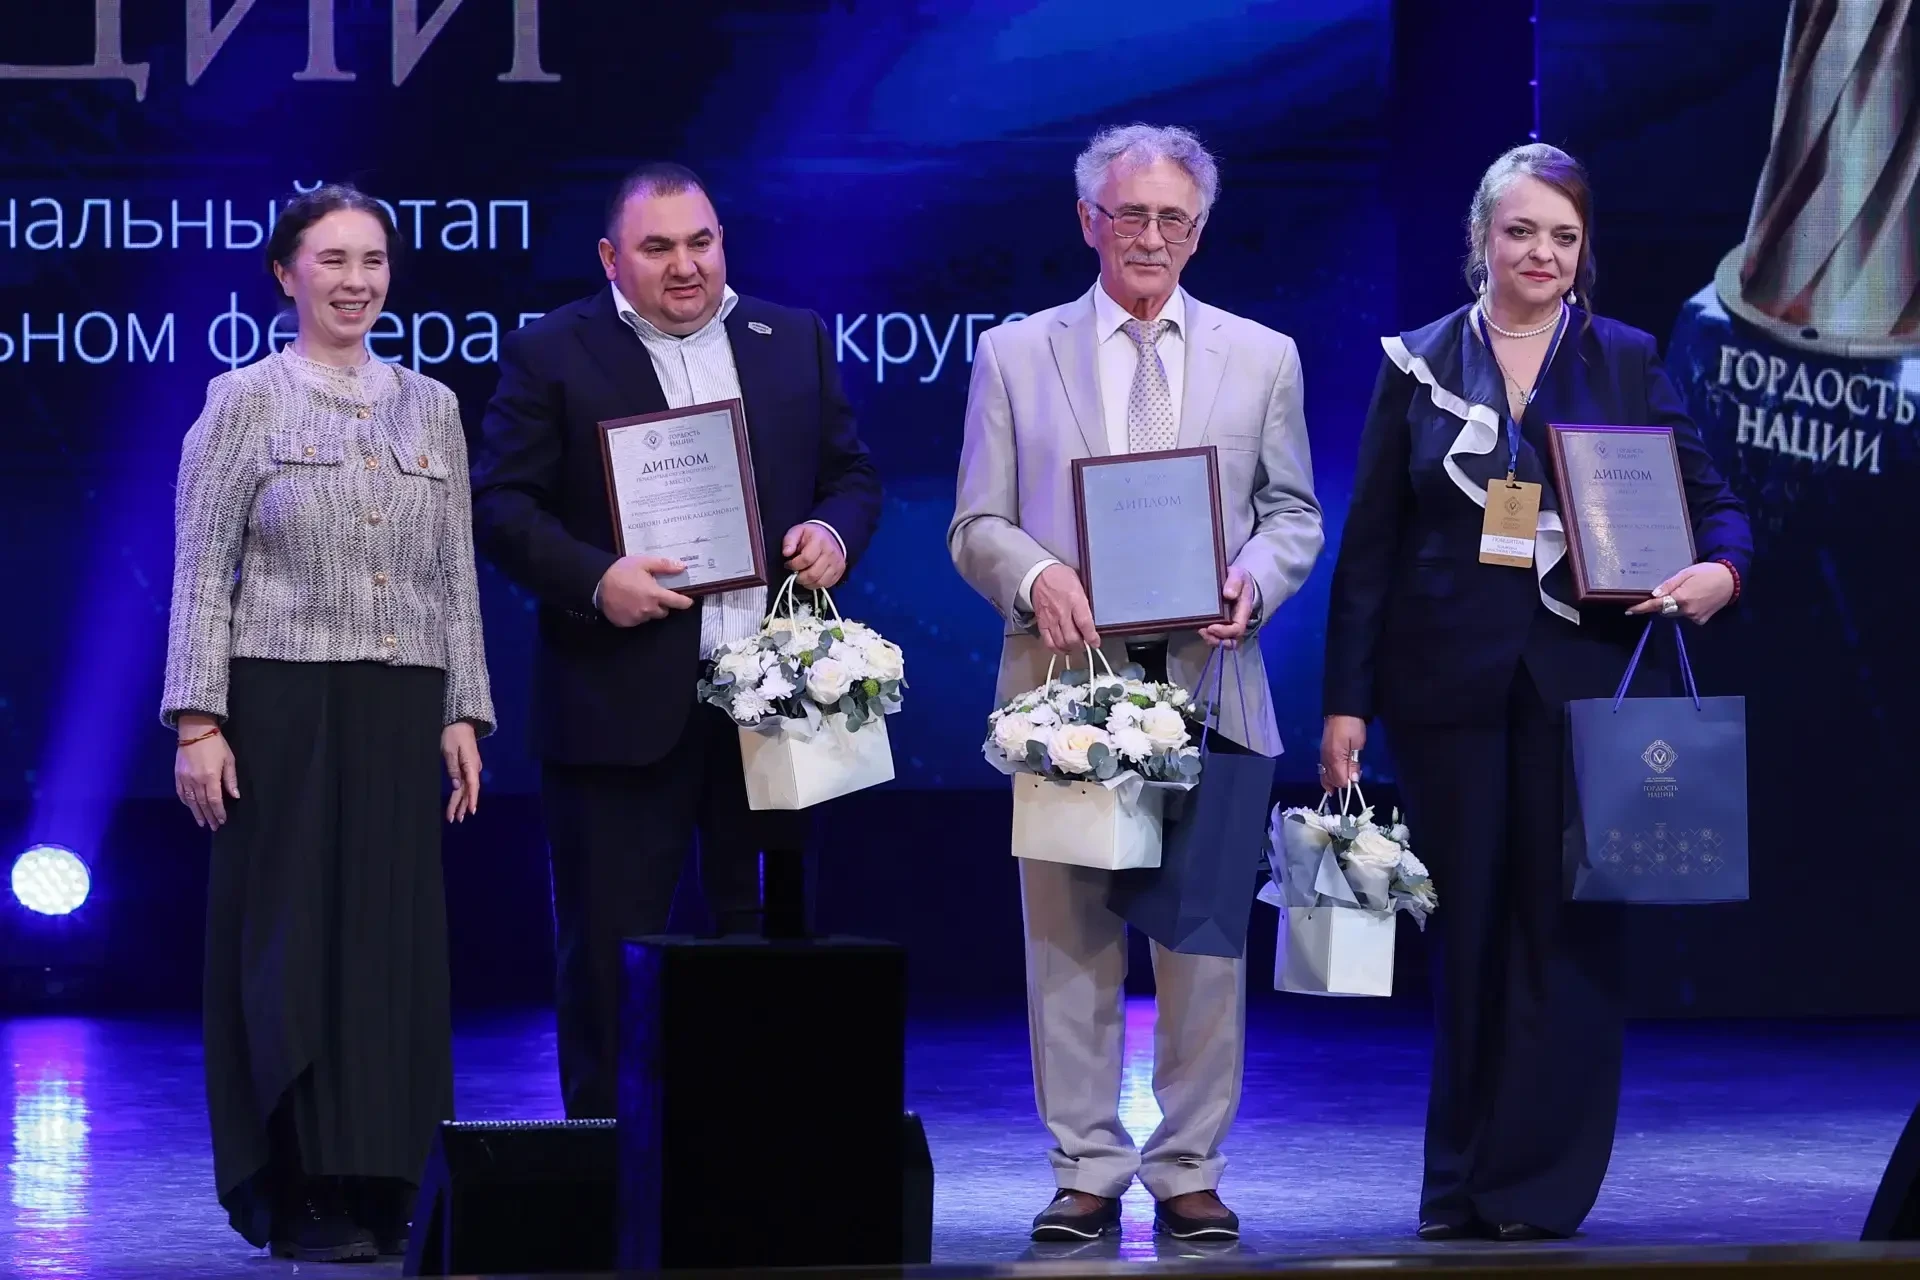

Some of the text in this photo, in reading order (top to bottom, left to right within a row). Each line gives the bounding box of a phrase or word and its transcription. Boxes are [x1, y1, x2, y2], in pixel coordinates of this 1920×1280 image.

[0, 180, 323, 250] альны
[836, 312, 1030, 383] круг
[1719, 345, 1915, 425] ГОРДОСТЬ
[642, 452, 709, 475] ДИПЛОМ
[1736, 403, 1882, 474] НАЦИИ
[1114, 495, 1182, 511] ДИПЛОМ
[1593, 468, 1652, 480] ДИПЛОМ
